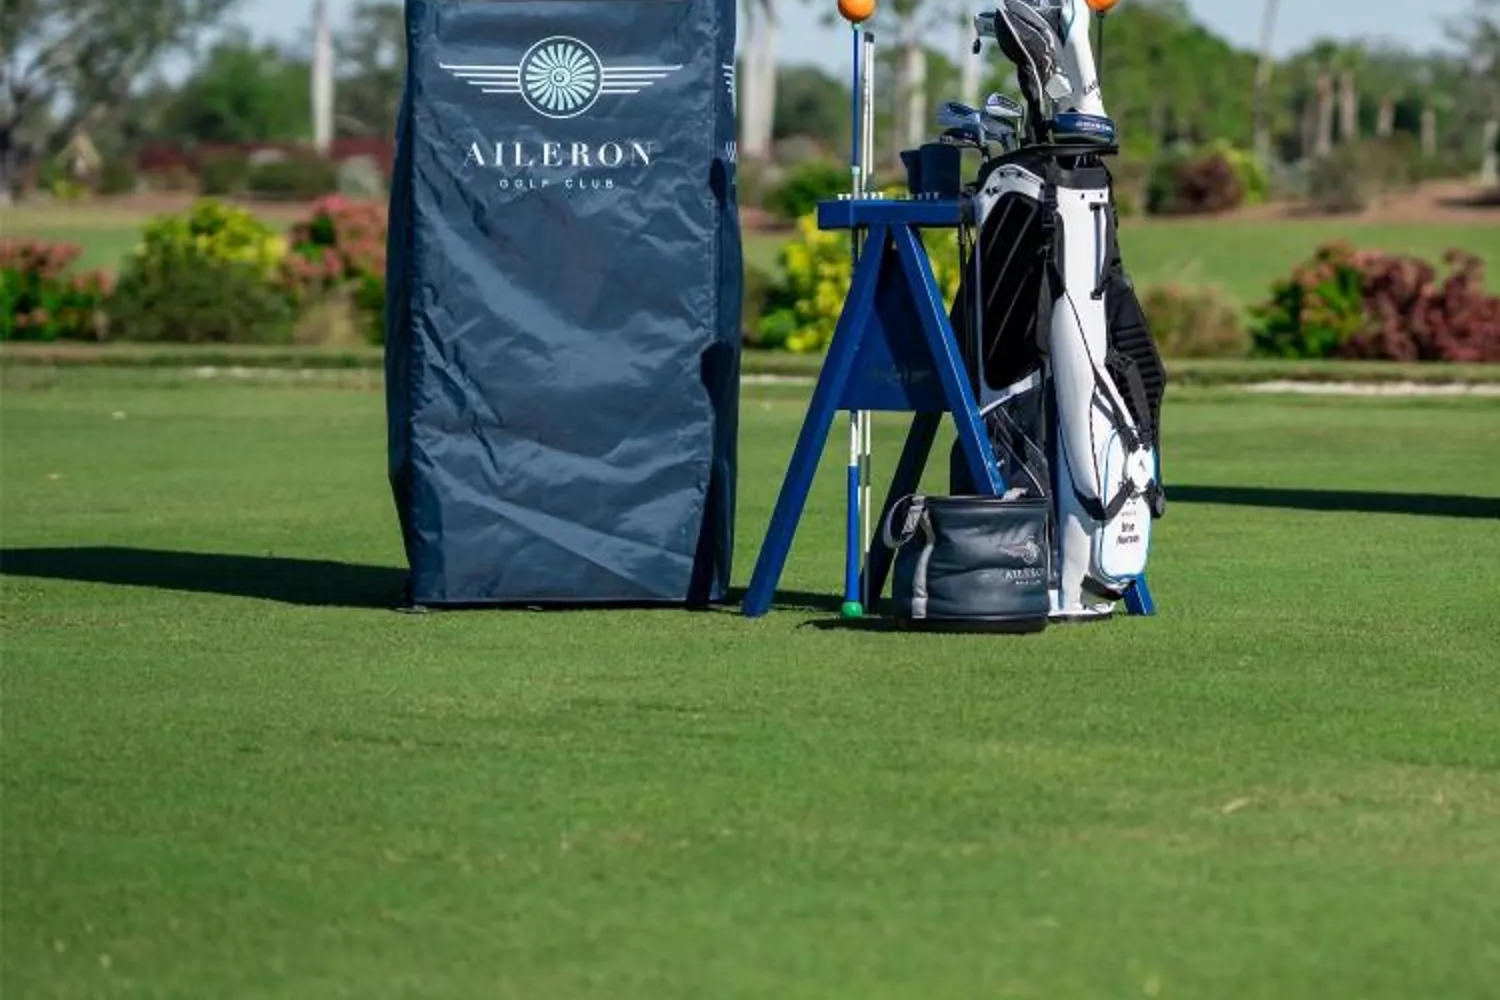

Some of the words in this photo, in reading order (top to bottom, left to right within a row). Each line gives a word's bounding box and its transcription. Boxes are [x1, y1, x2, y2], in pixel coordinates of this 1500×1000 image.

[463, 140, 657, 168] AILERON
[499, 178, 551, 190] GOLF
[564, 178, 615, 190] CLUB
